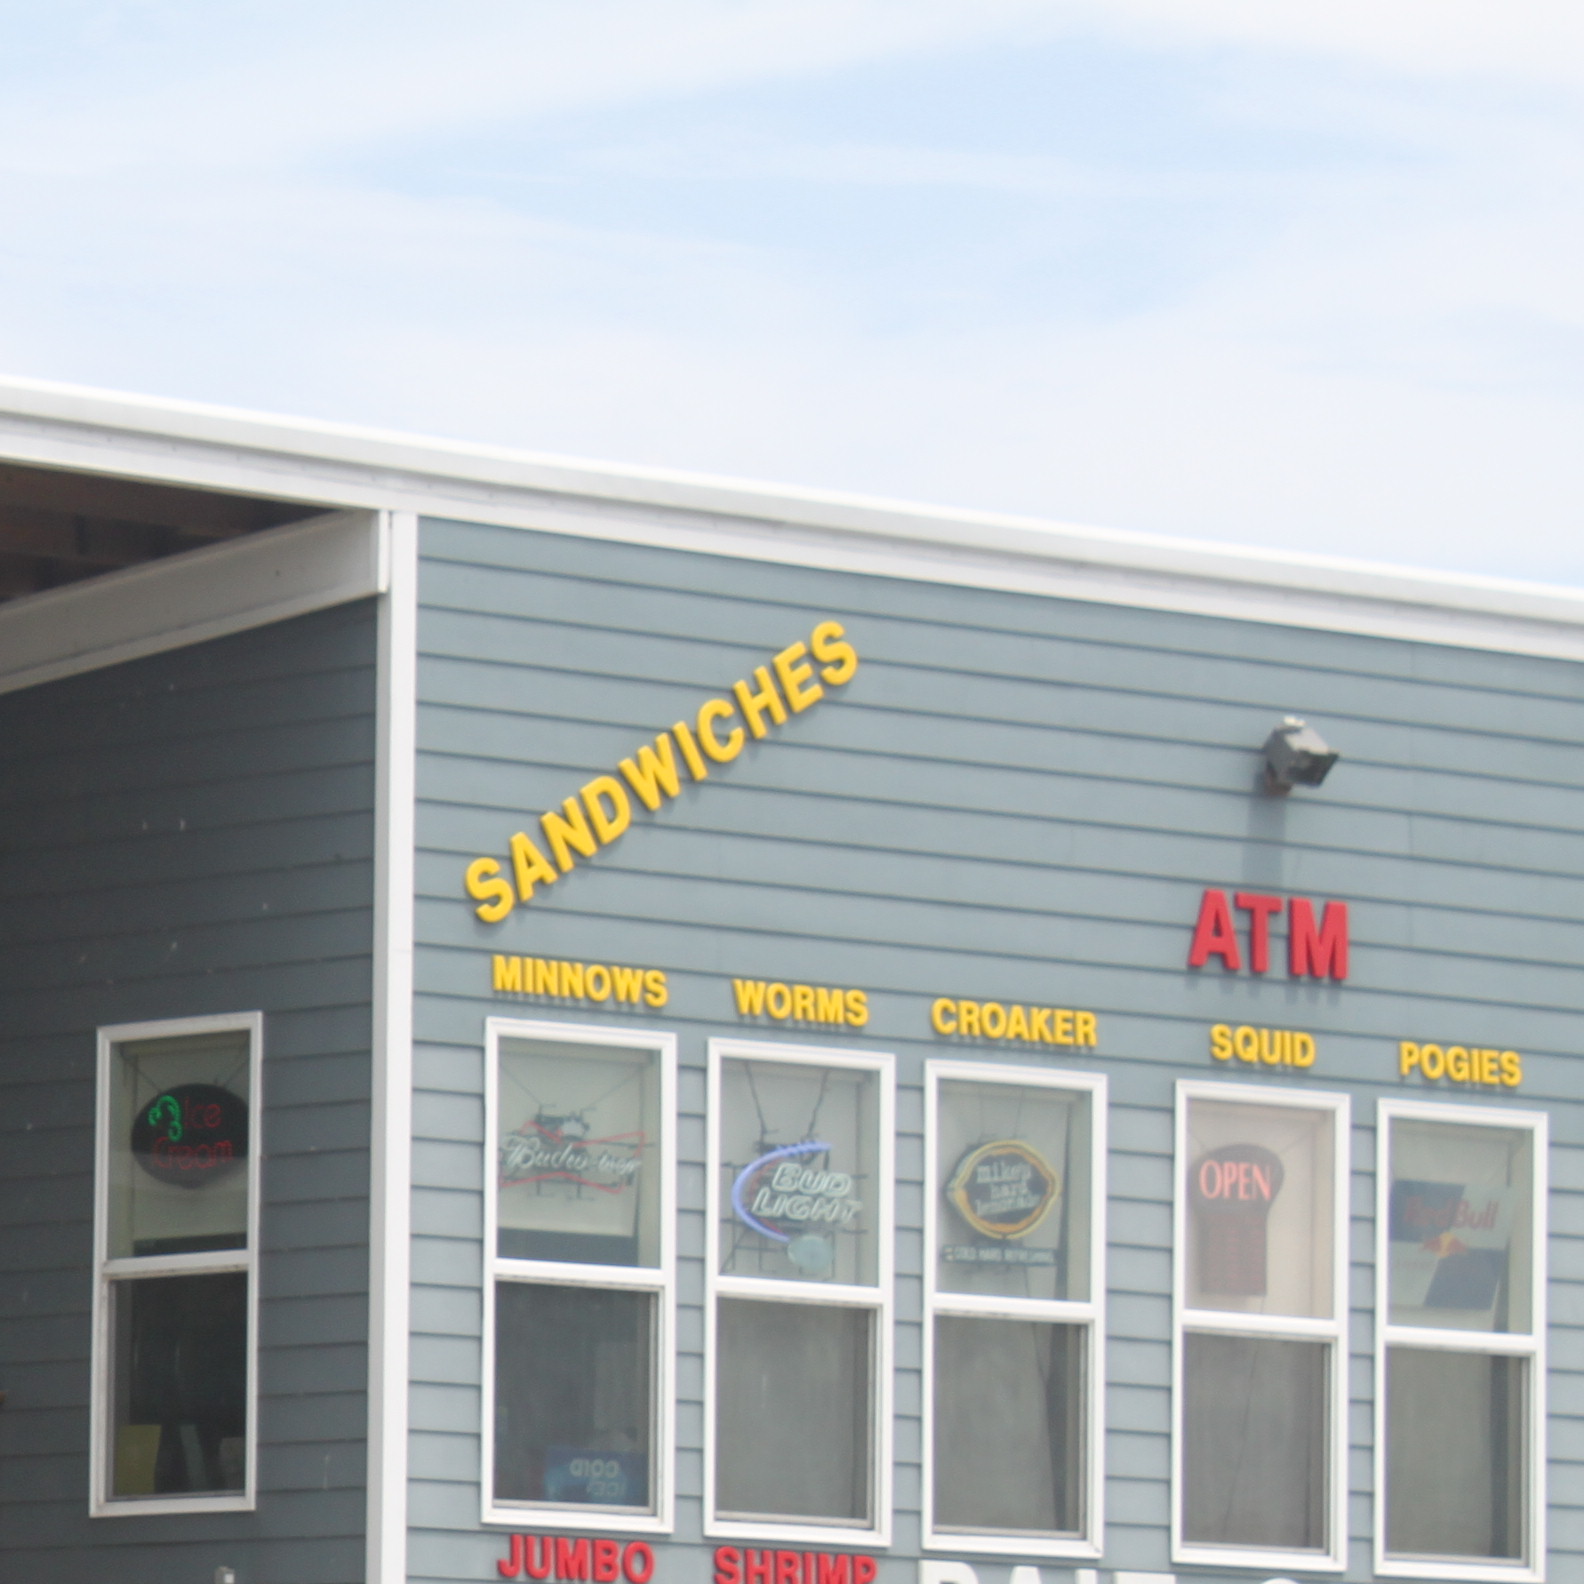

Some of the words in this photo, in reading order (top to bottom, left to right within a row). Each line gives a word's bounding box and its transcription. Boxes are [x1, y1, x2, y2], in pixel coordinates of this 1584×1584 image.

[464, 620, 860, 924] SANDWICHES
[1188, 888, 1349, 980] ATM
[492, 955, 668, 1007] MINNOWS
[734, 979, 869, 1027] WORMS
[932, 997, 1098, 1047] CROAKER
[1211, 1024, 1316, 1067] SQUID
[1400, 1041, 1523, 1087] POGIES
[772, 1163, 852, 1197] BUD
[1200, 1160, 1272, 1200] OPEN
[752, 1190, 864, 1224] LIGHT
[497, 1534, 655, 1584] JUMBO
